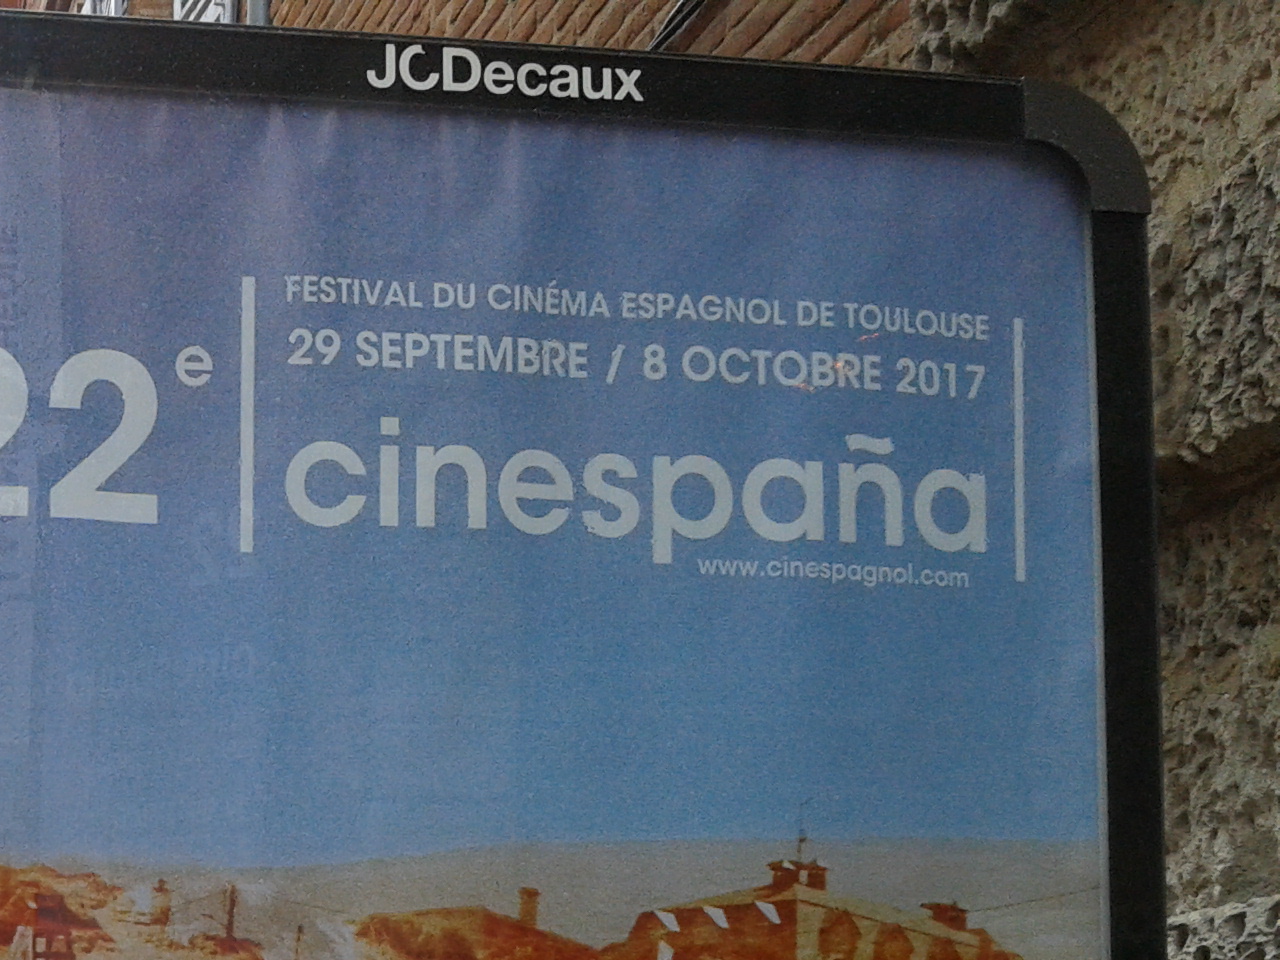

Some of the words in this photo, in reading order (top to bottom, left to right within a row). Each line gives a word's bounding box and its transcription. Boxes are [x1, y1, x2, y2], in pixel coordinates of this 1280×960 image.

[367, 43, 644, 102] JCDecaux
[285, 274, 423, 308] FESTIVAL
[433, 283, 476, 309] DU
[487, 280, 611, 318] CINÉMA
[621, 292, 786, 326] ESPAGNOL
[797, 300, 836, 328] DE
[843, 303, 990, 341] TOULOUSE
[287, 328, 342, 366] 29
[355, 331, 588, 380] SEPTEMBRE
[605, 343, 626, 385] /
[643, 344, 668, 381] 8
[681, 344, 882, 392] OCTOBRE
[895, 356, 986, 400] 2017
[285, 416, 987, 565] cinespaña
[696, 556, 970, 588] www.cinespagnol.com
